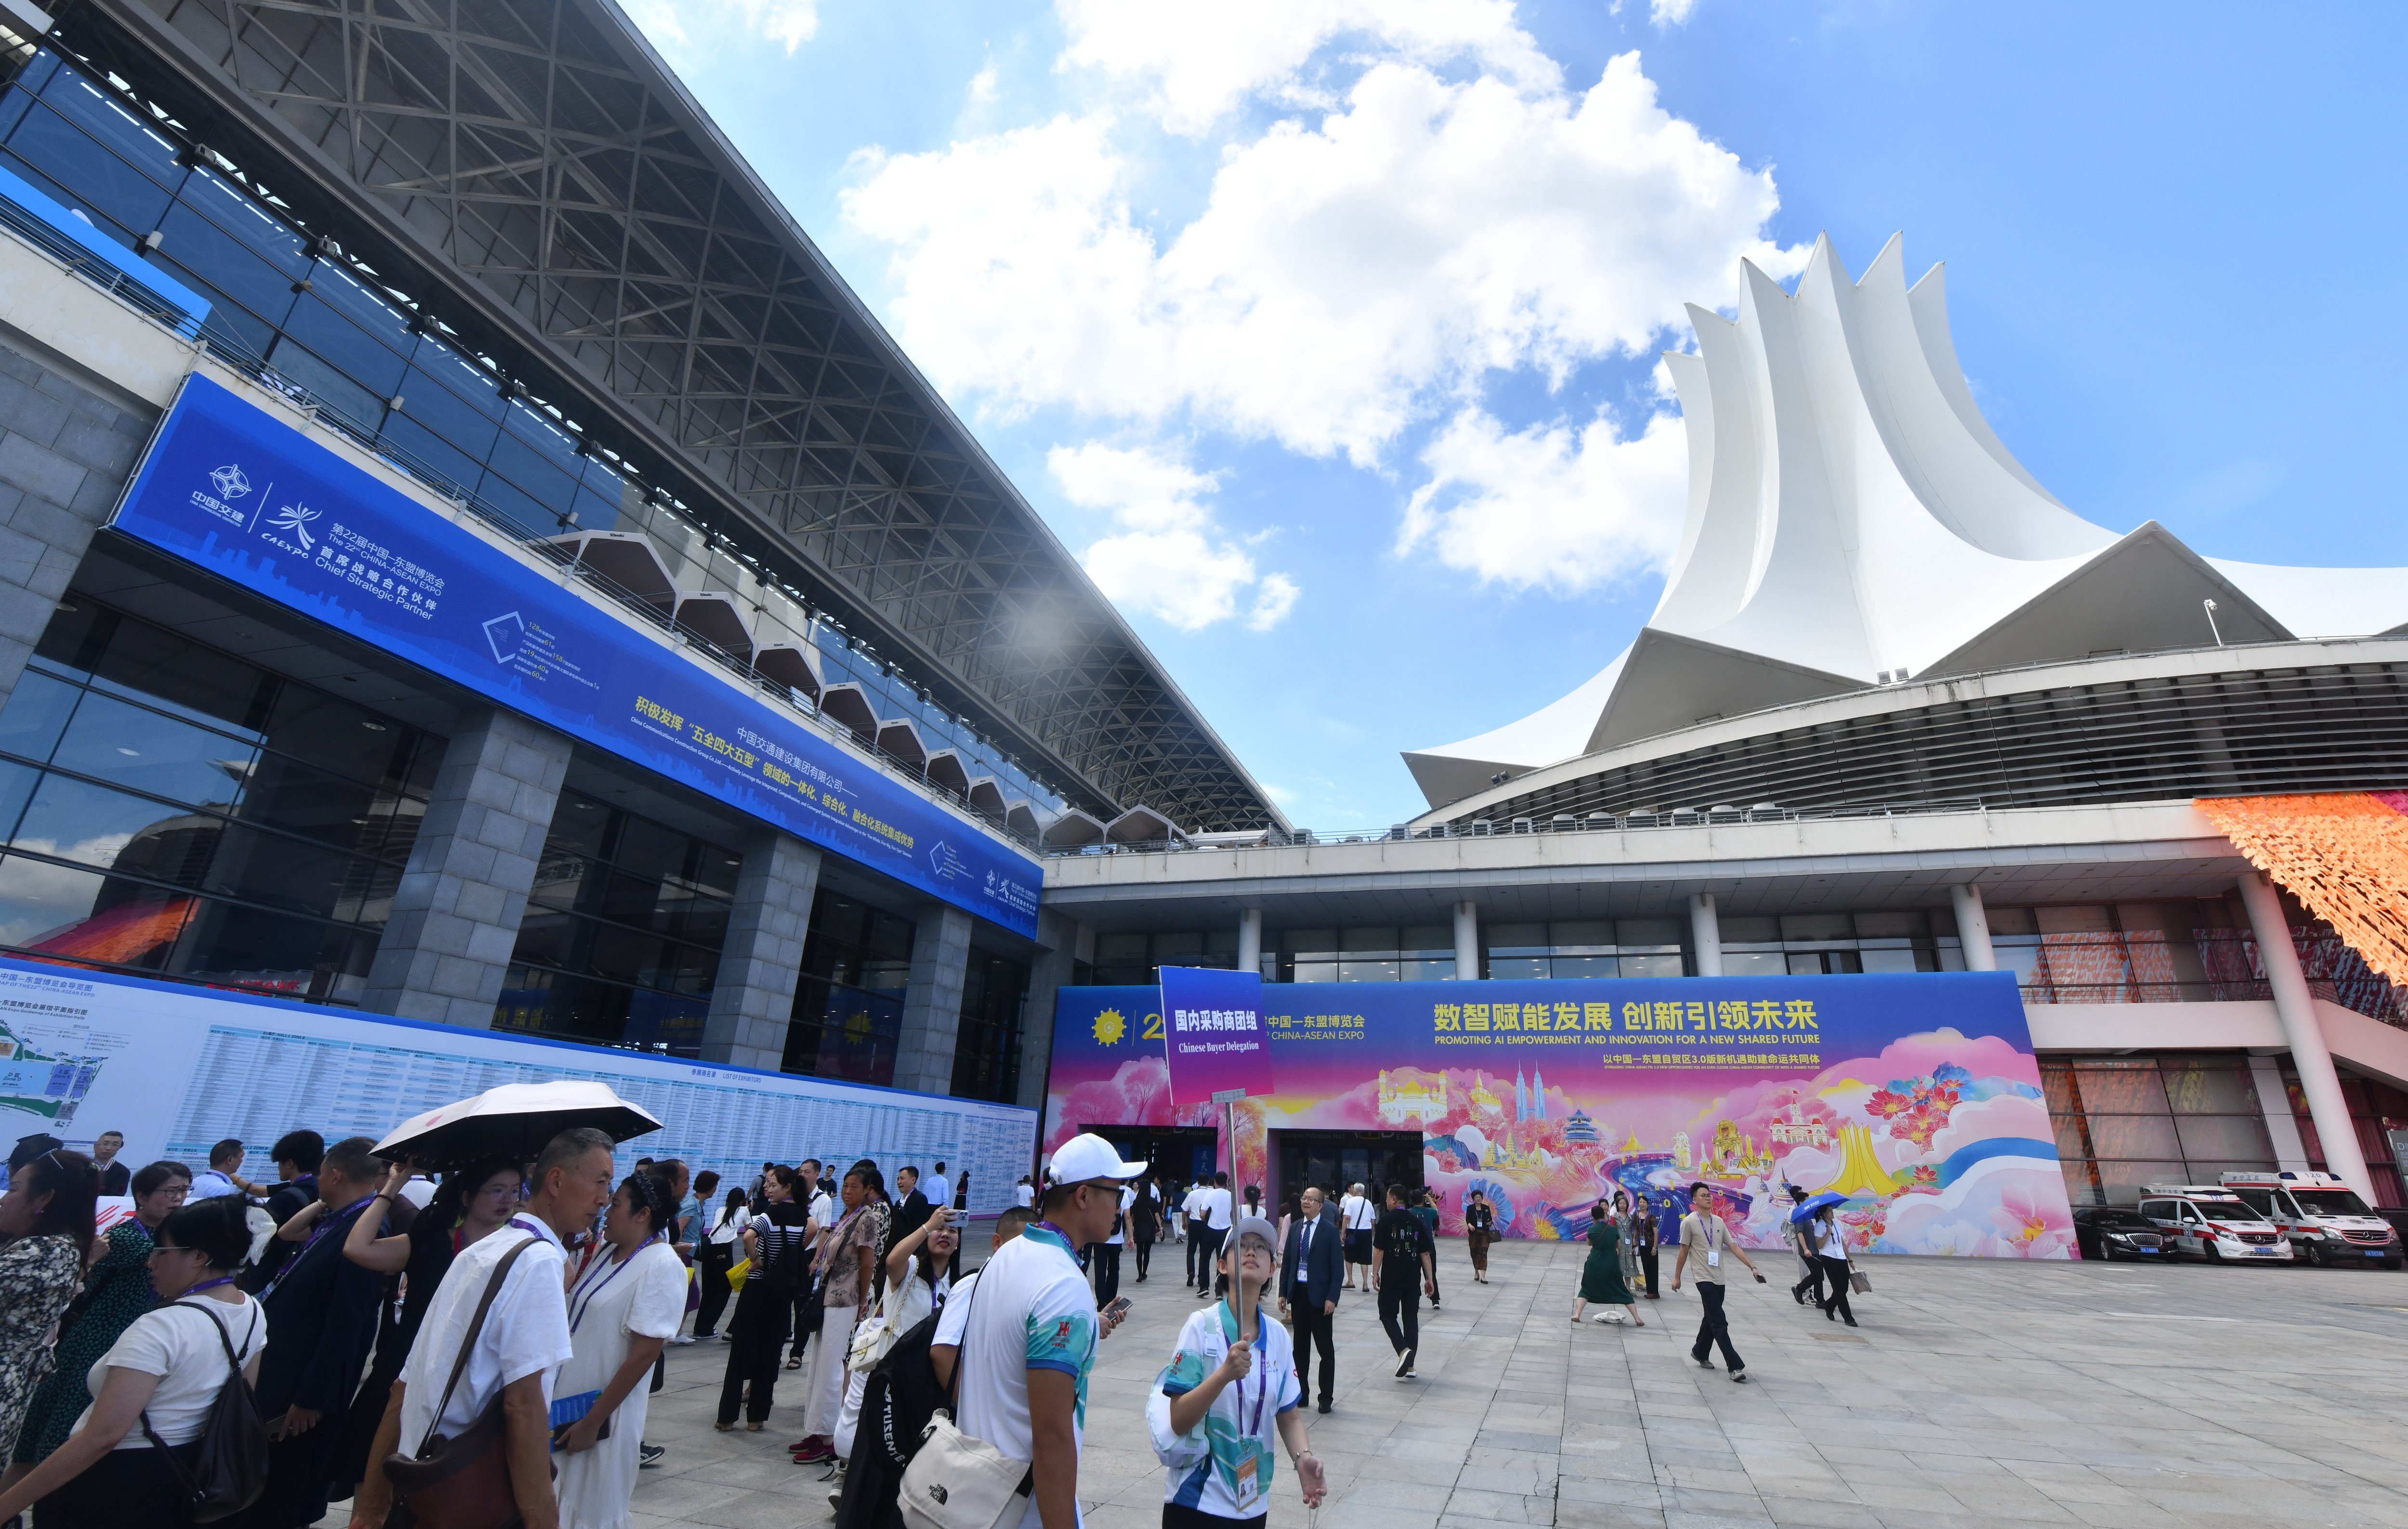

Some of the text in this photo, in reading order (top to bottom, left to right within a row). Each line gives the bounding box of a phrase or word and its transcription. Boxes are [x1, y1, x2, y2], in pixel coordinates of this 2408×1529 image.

[192, 490, 245, 523] 中国交建
[222, 516, 241, 527] CONSTRUCTION
[261, 533, 309, 559] CAEXPO
[328, 533, 343, 546] The
[360, 550, 419, 585] CHINA-ASEAN
[419, 582, 441, 596] EXPO
[320, 546, 437, 611] 首席战略合作伙伴
[315, 557, 433, 620] Chief Strategic Partner
[631, 716, 642, 726] China
[643, 722, 674, 742] Communications
[674, 738, 698, 754] Construction
[698, 750, 709, 759] Group
[741, 771, 756, 782] Leverage
[778, 789, 800, 805] Comprehensive,
[807, 803, 821, 814] Converged
[821, 810, 831, 819] System
[830, 815, 845, 826] Integration
[1016, 903, 1026, 913] Strategic
[42, 987, 79, 996] CHINA-ASEAN
[1174, 1009, 1257, 1032] 国内采购商团组
[1434, 999, 1819, 1032] 数智赋能发展 创新引领未来
[1265, 1015, 1365, 1029] 中国—东盟博览会
[1271, 1031, 1364, 1040] CHINA-ASEAN EXPO
[1435, 1034, 1820, 1045] PROMOTING AI EMPOWERMENT AND INNOVATION FOR A NEW SHARED FUTURE
[1178, 1040, 1259, 1055] Chinese Buyer Delegation
[691, 1068, 716, 1078] 参展商名录
[738, 1074, 761, 1084] EXHIBITORS
[1663, 1199, 1671, 1207] 0
[2183, 1228, 2193, 1238] 120
[929, 1485, 942, 1496] NORTH
[929, 1491, 940, 1502] FACE
